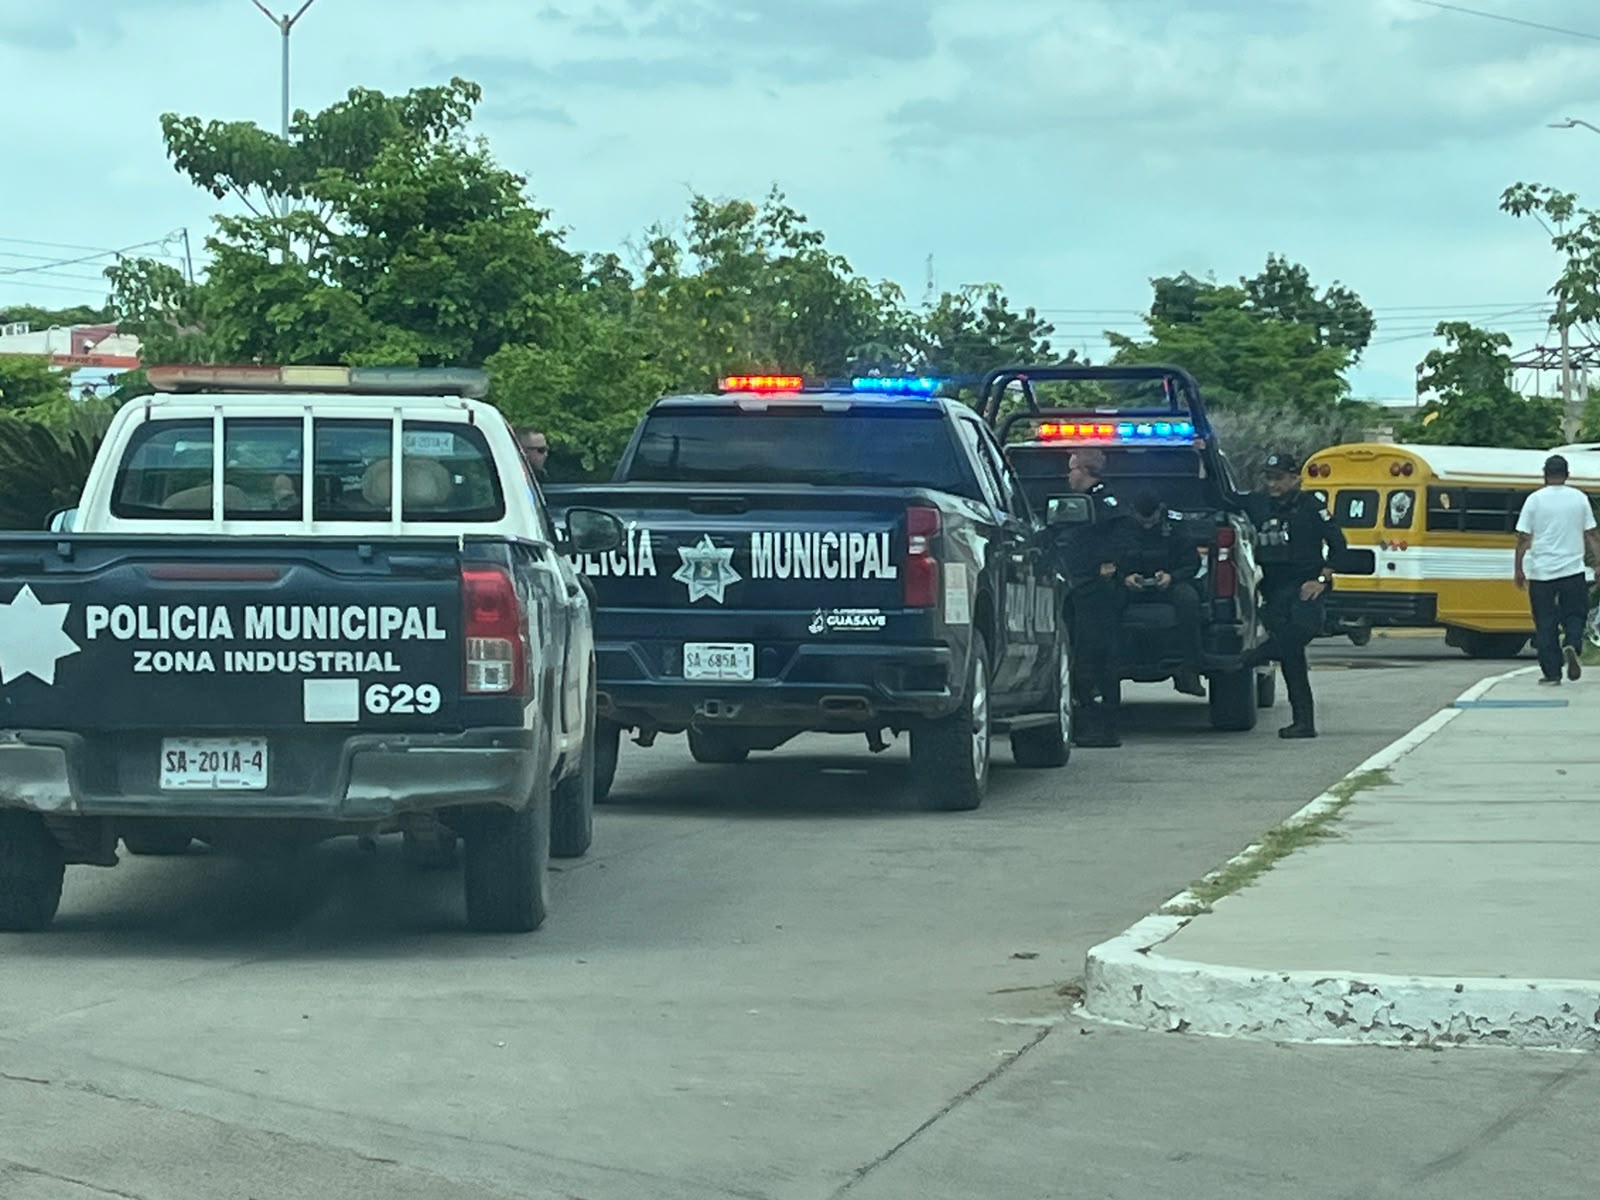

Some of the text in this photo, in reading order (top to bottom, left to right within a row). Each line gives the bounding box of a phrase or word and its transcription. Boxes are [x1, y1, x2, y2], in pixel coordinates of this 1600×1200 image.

[555, 521, 898, 579] LICÍA MUNICIPAL
[86, 605, 446, 642] POLICIA MUNICIPAL
[134, 649, 400, 674] ZONA INDUSTRIAL
[364, 684, 441, 713] 629
[164, 750, 263, 773] SA-201A-4
